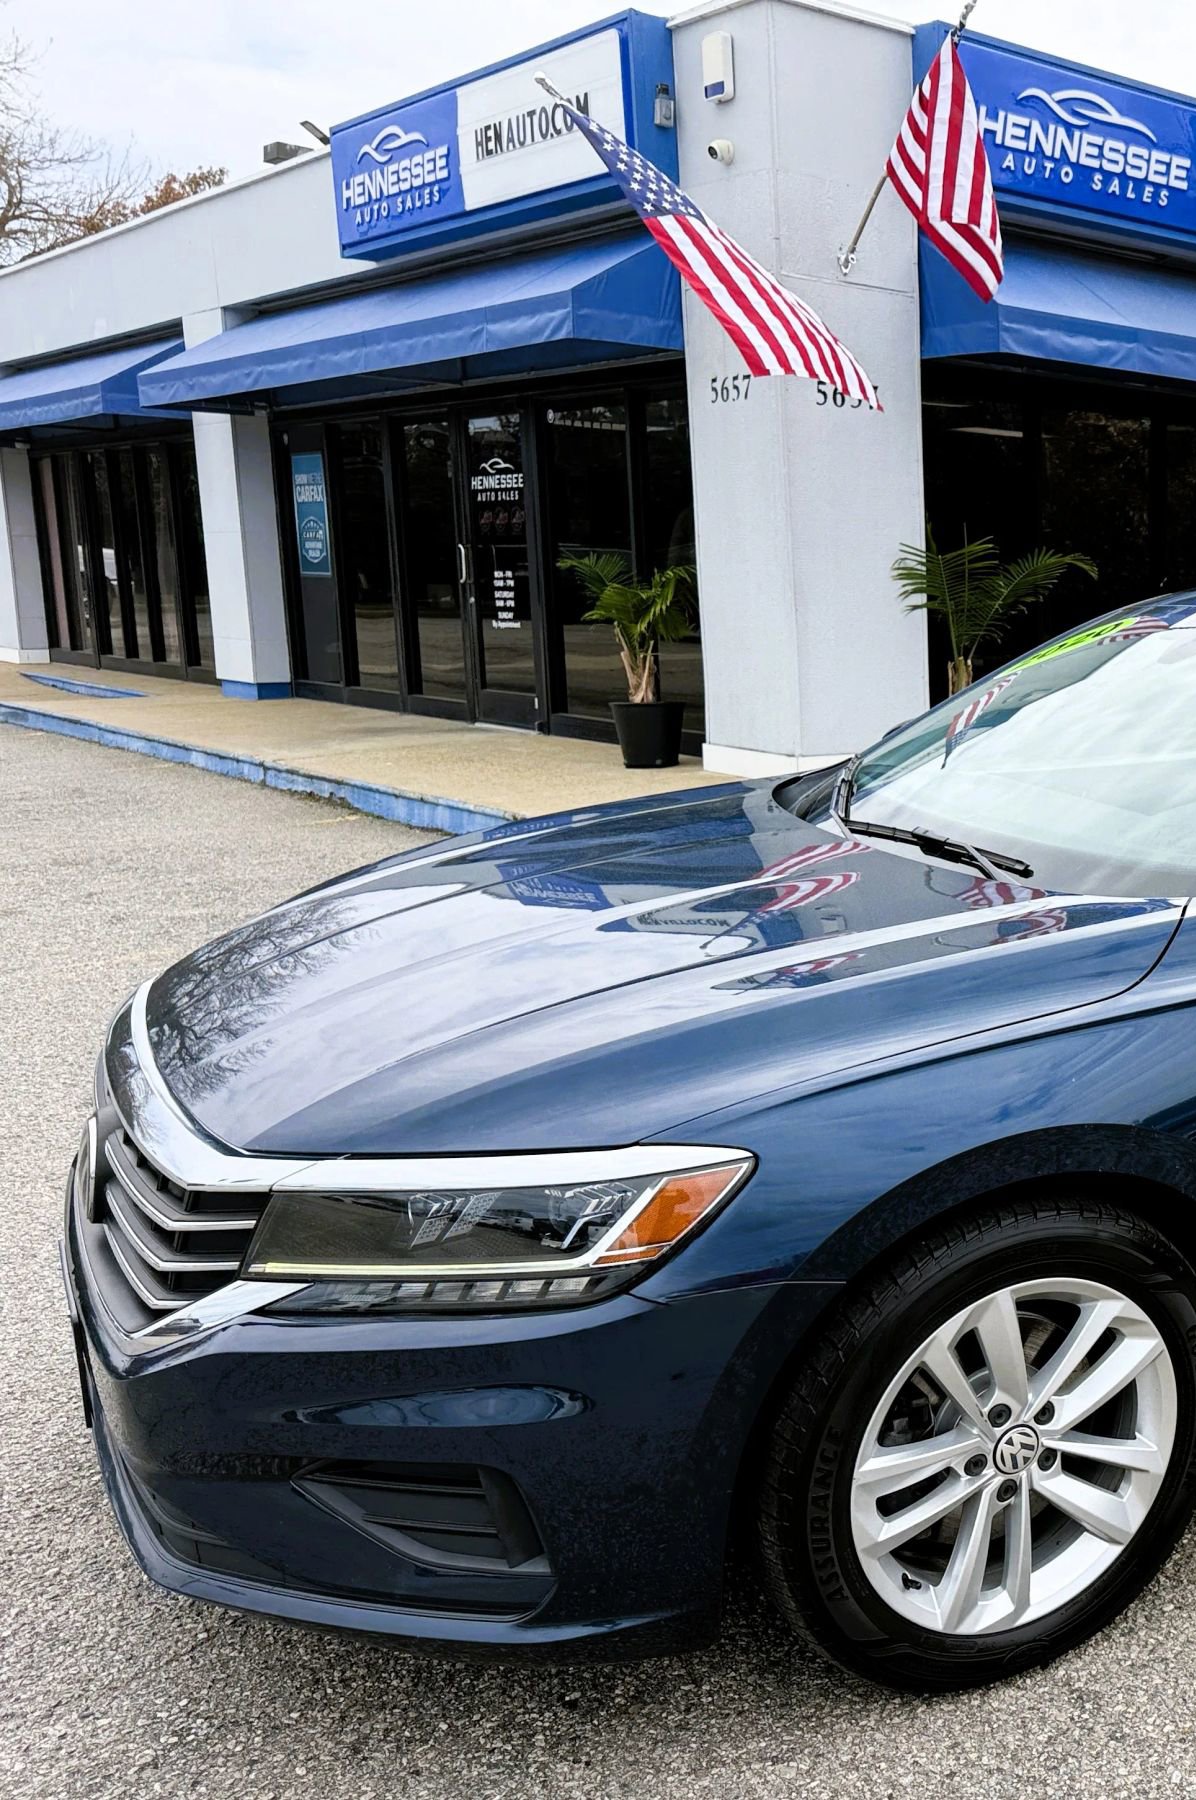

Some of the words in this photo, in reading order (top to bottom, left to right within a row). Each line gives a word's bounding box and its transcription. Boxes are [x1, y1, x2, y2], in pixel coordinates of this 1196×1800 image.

[978, 105, 1191, 190] HENNESSEE
[342, 144, 449, 210] HENNESSEE
[1002, 151, 1074, 184] AUTO
[1092, 172, 1169, 206] SALES
[355, 201, 389, 225] AUTO
[397, 184, 440, 213] SALES
[710, 374, 752, 403] 5657
[816, 380, 879, 410] 56
[296, 485, 324, 502] CARFAX
[471, 473, 524, 490] HENNESSEE
[477, 491, 495, 502] AUTO
[498, 490, 519, 501] SALES
[810, 1424, 848, 1602] ASSURANCE
